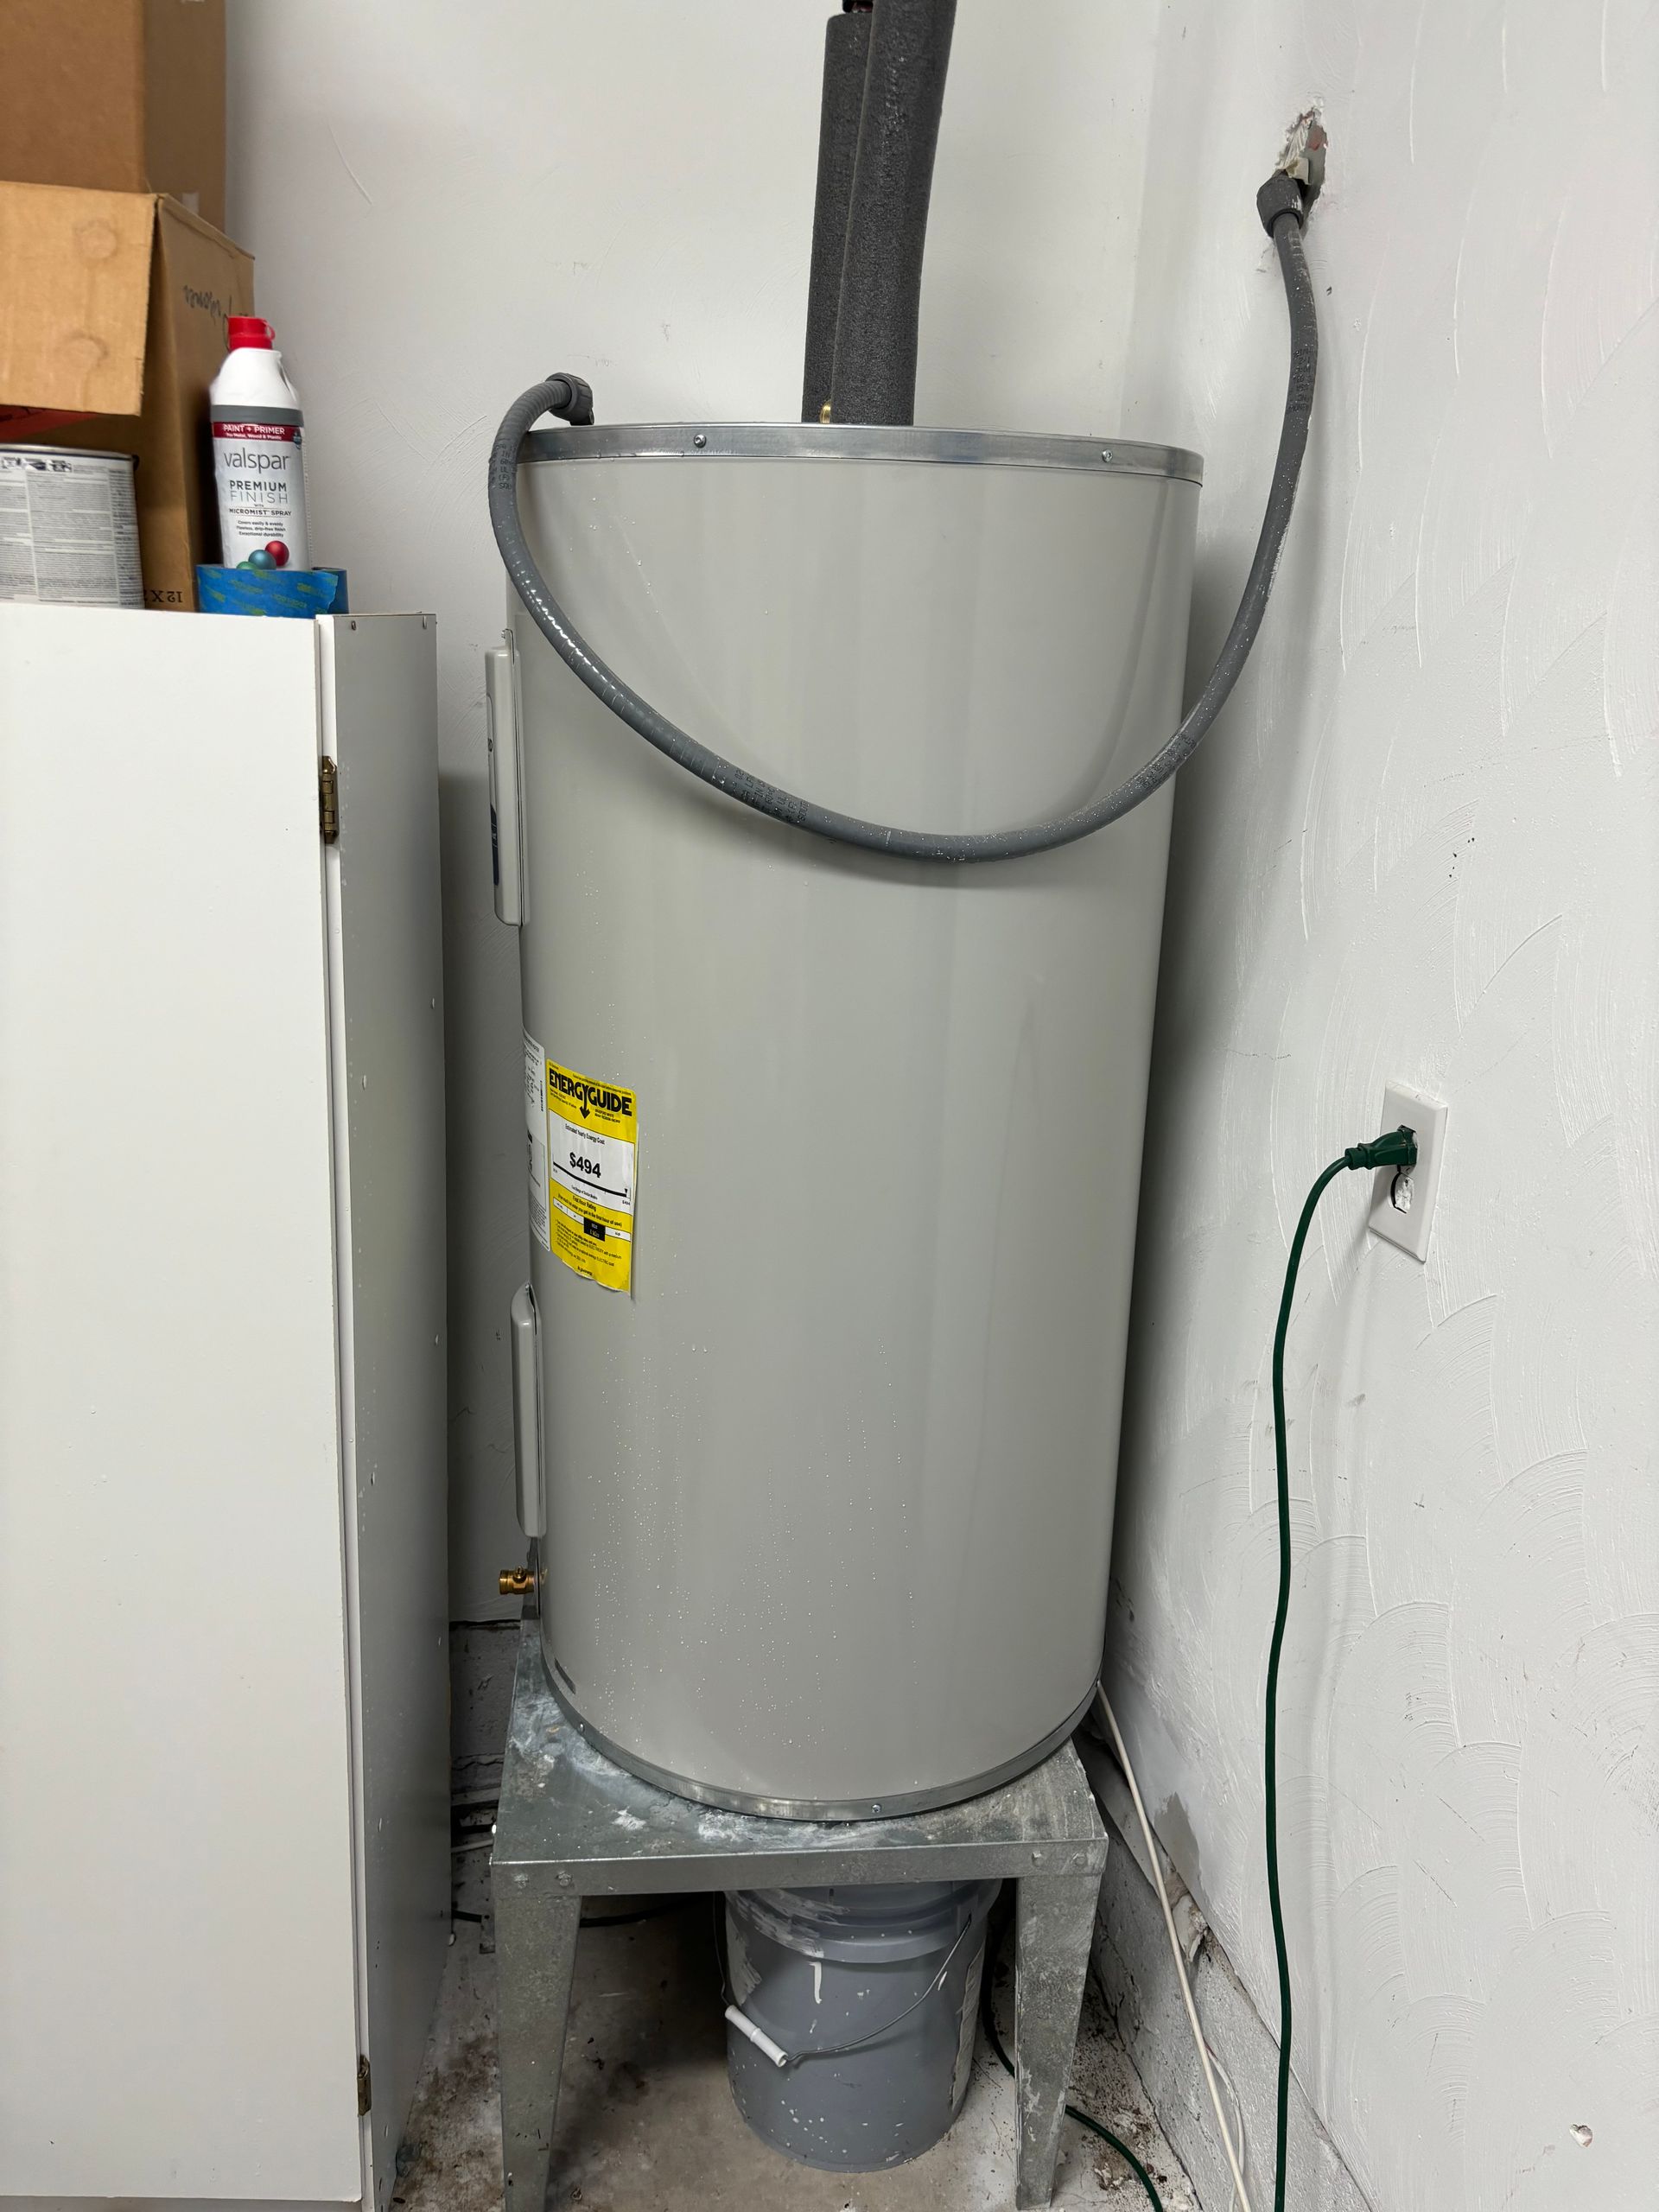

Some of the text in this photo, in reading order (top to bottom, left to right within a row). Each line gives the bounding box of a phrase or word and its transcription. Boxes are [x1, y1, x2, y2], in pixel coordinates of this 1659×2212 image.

[223, 423, 245, 432] PAINT
[254, 425, 285, 435] PRIMER
[224, 447, 289, 474] valspar
[230, 480, 287, 492] PREMIUM
[231, 490, 288, 504] FINISH
[587, 1134, 597, 1143] Energy
[569, 1152, 601, 1179] $494
